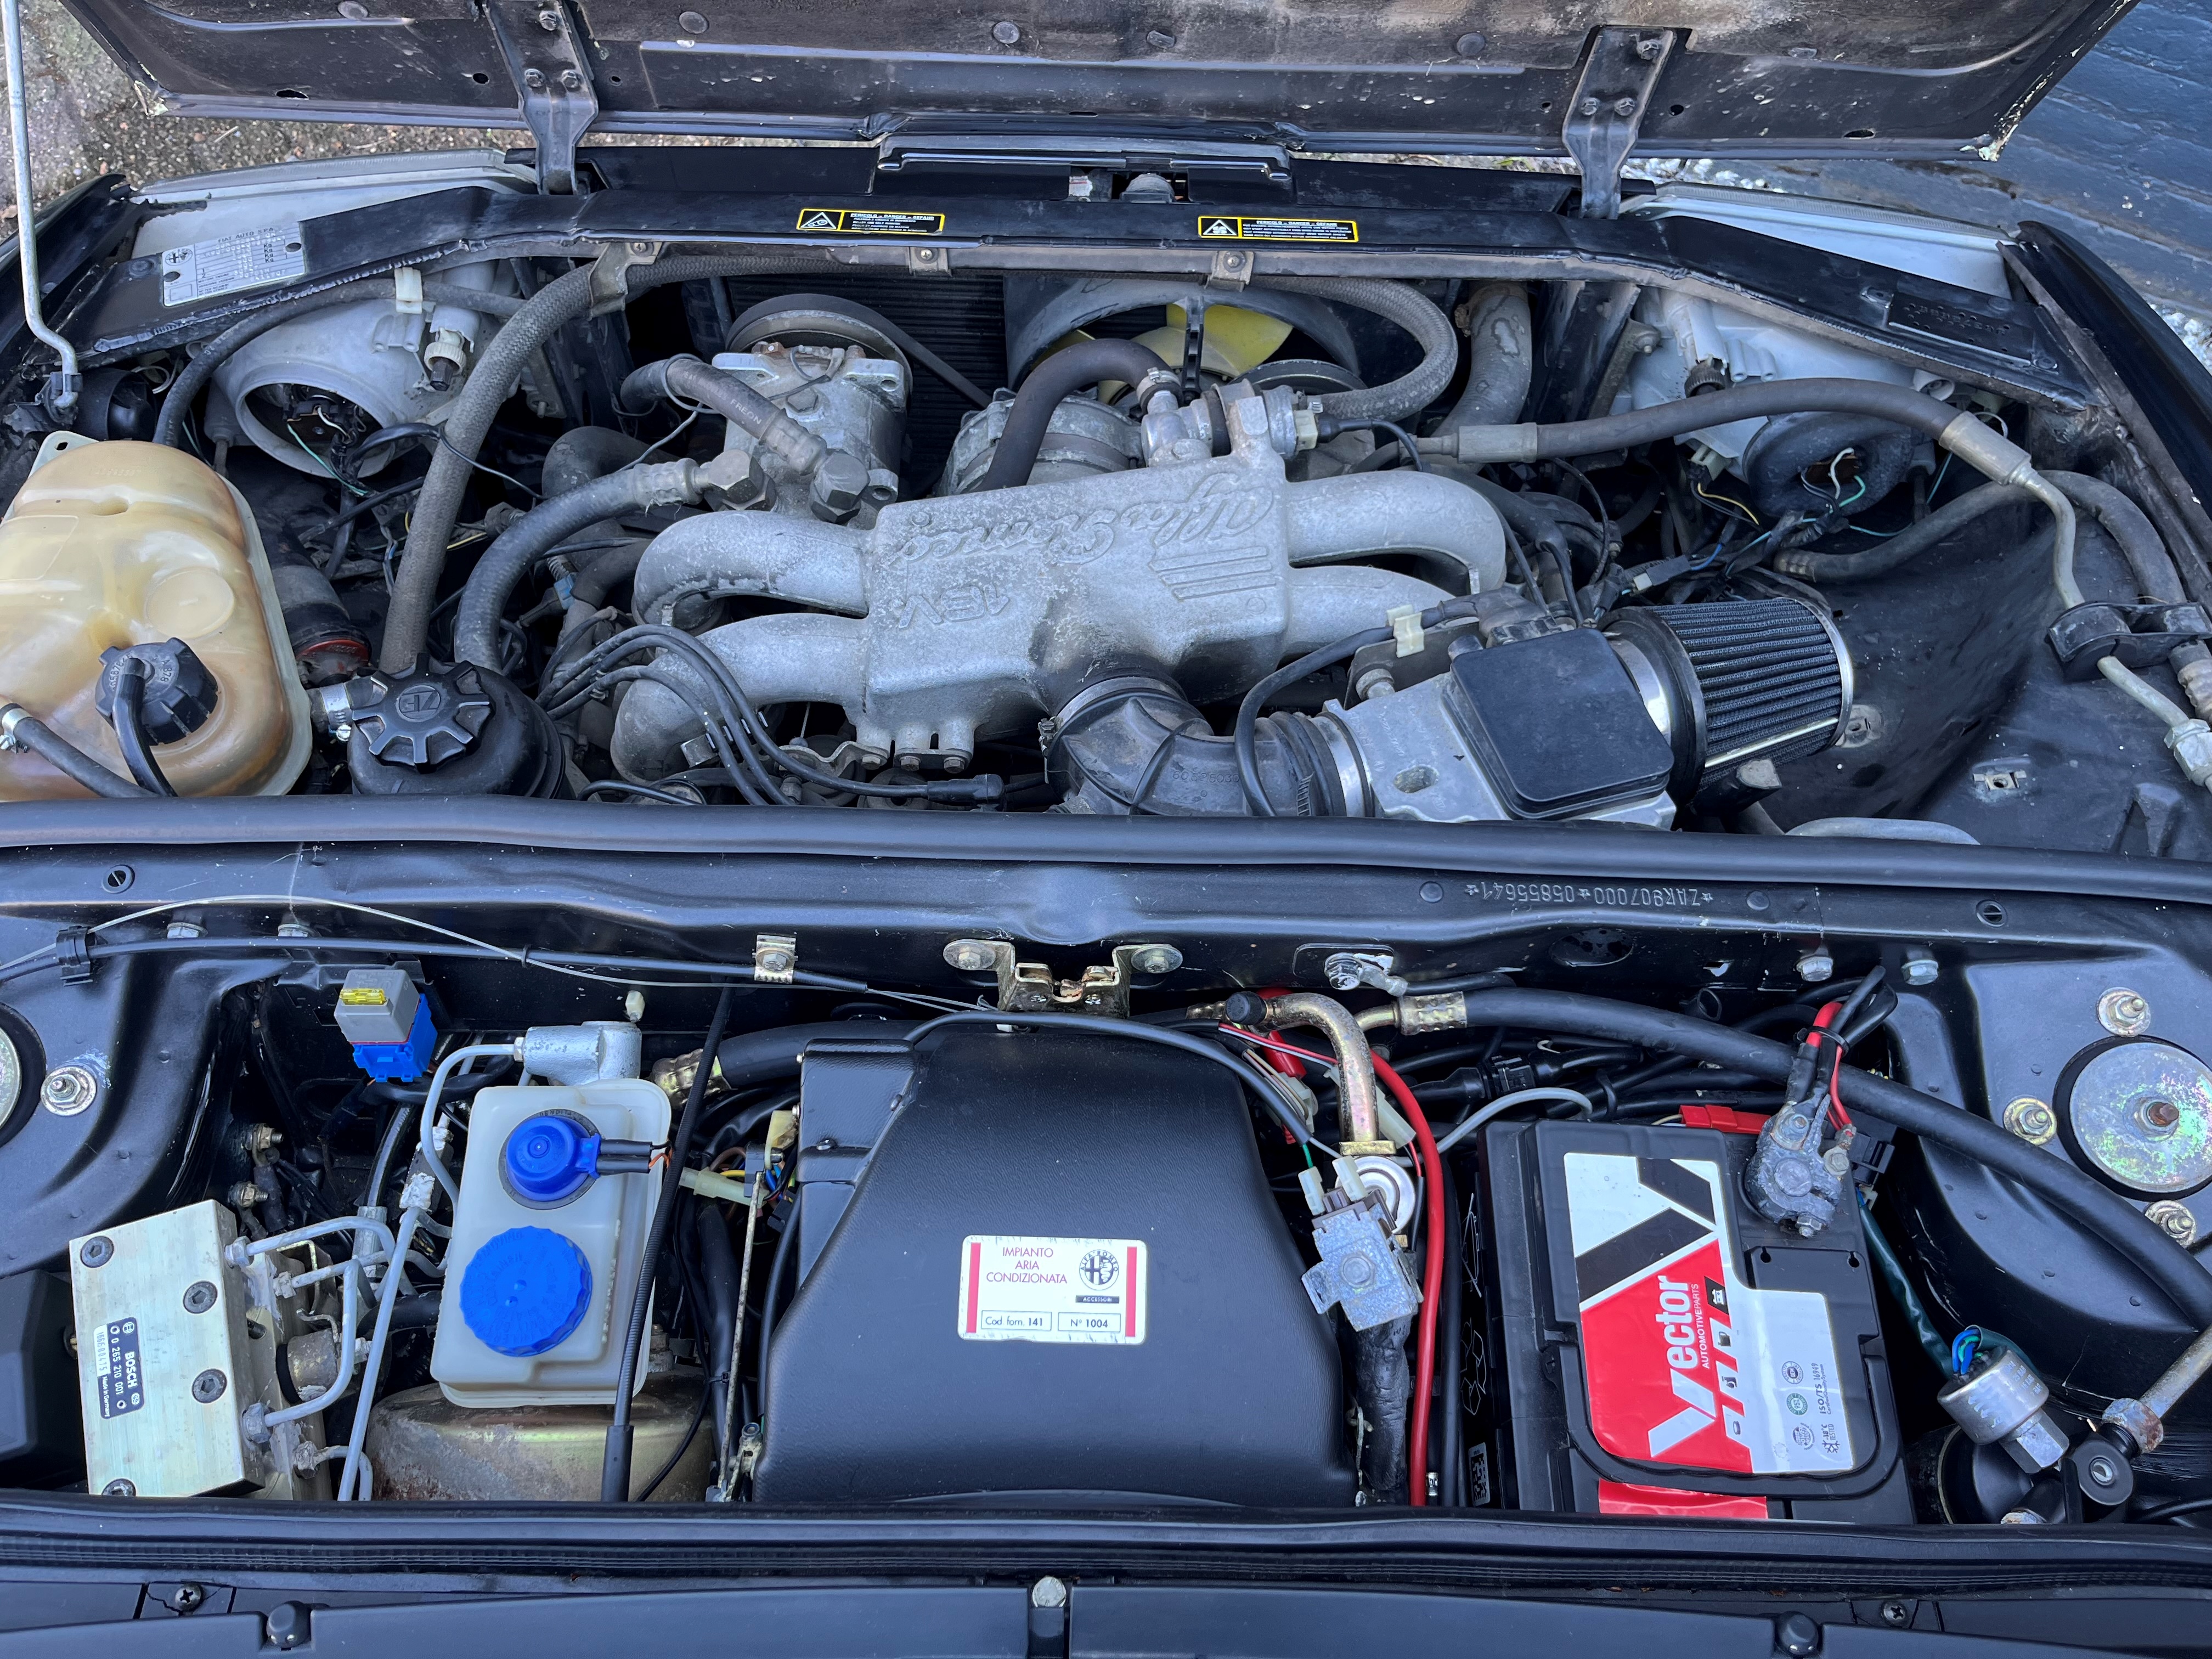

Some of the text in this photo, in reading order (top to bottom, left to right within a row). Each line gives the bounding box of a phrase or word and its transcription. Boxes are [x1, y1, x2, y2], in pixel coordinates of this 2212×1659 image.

[235, 231, 254, 239] AUTO
[729, 398, 764, 426] FREON
[1118, 472, 1273, 549] Alfa
[402, 691, 438, 714] ZF
[1173, 770, 1240, 783] 60525030
[1003, 1247, 1053, 1258] IMPIANTO
[1015, 1260, 1039, 1270] ARIA
[1080, 1250, 1119, 1272] ALFA ROMEO
[986, 1272, 1068, 1284] CONDIZIONATA
[1028, 1317, 1043, 1326] 141
[1086, 1319, 1108, 1328] 1004
[1691, 1283, 1709, 1369] AUTOMOTIVEPARTS
[111, 1347, 121, 1362] 265
[113, 1365, 122, 1378] 210
[125, 1352, 138, 1389] BOSCH
[1648, 1275, 1717, 1458] Vector
[115, 1381, 124, 1395] 001
[1812, 1363, 1826, 1414] ISO/TS 16949
[1828, 1424, 1836, 1440] TESTED
